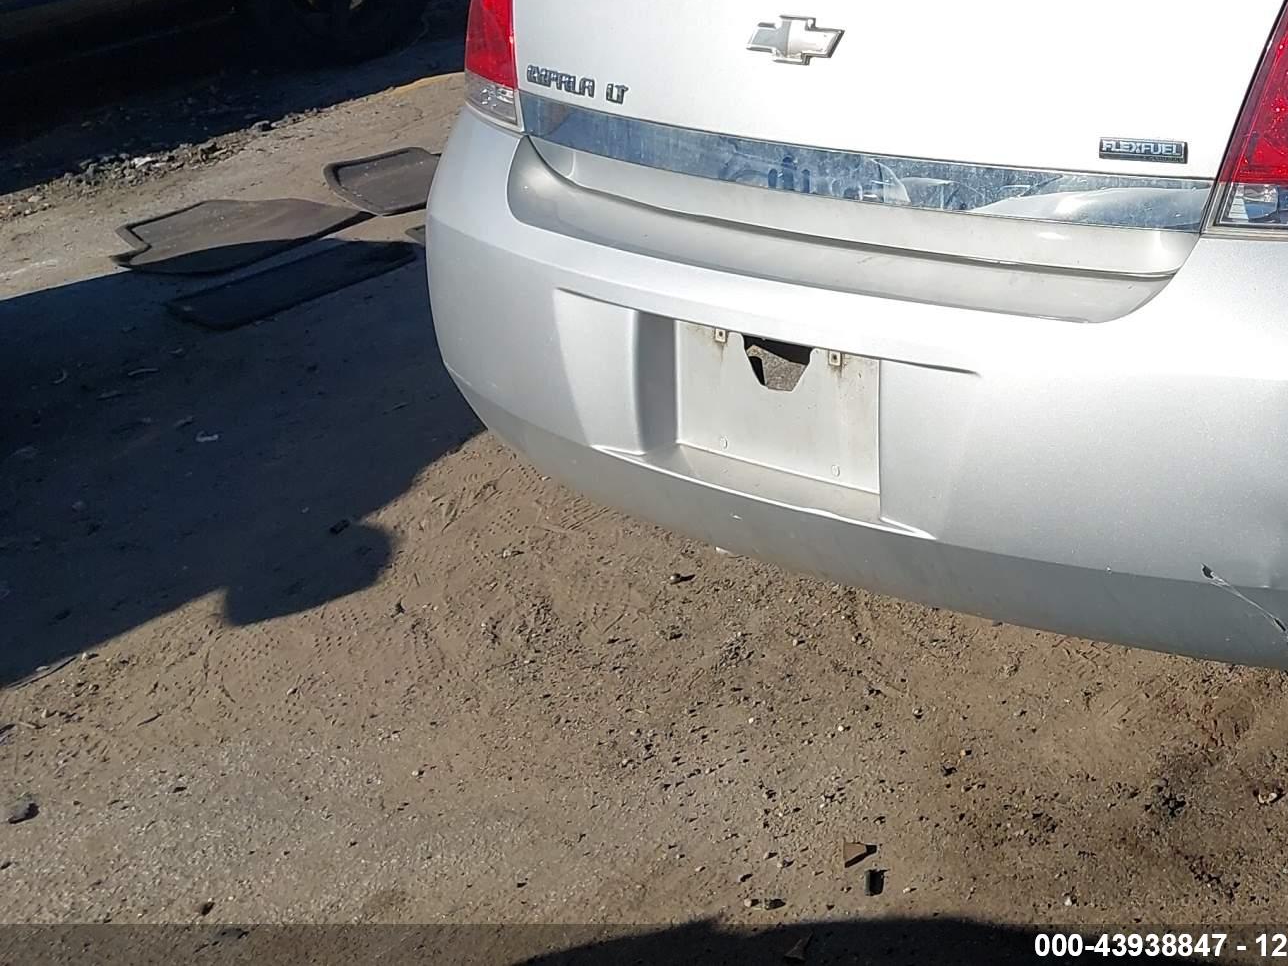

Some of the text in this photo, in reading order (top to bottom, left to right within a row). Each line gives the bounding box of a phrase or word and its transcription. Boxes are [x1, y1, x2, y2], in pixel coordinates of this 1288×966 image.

[526, 64, 629, 104] IMPALA LT
[1102, 140, 1184, 156] FLEXFUEL
